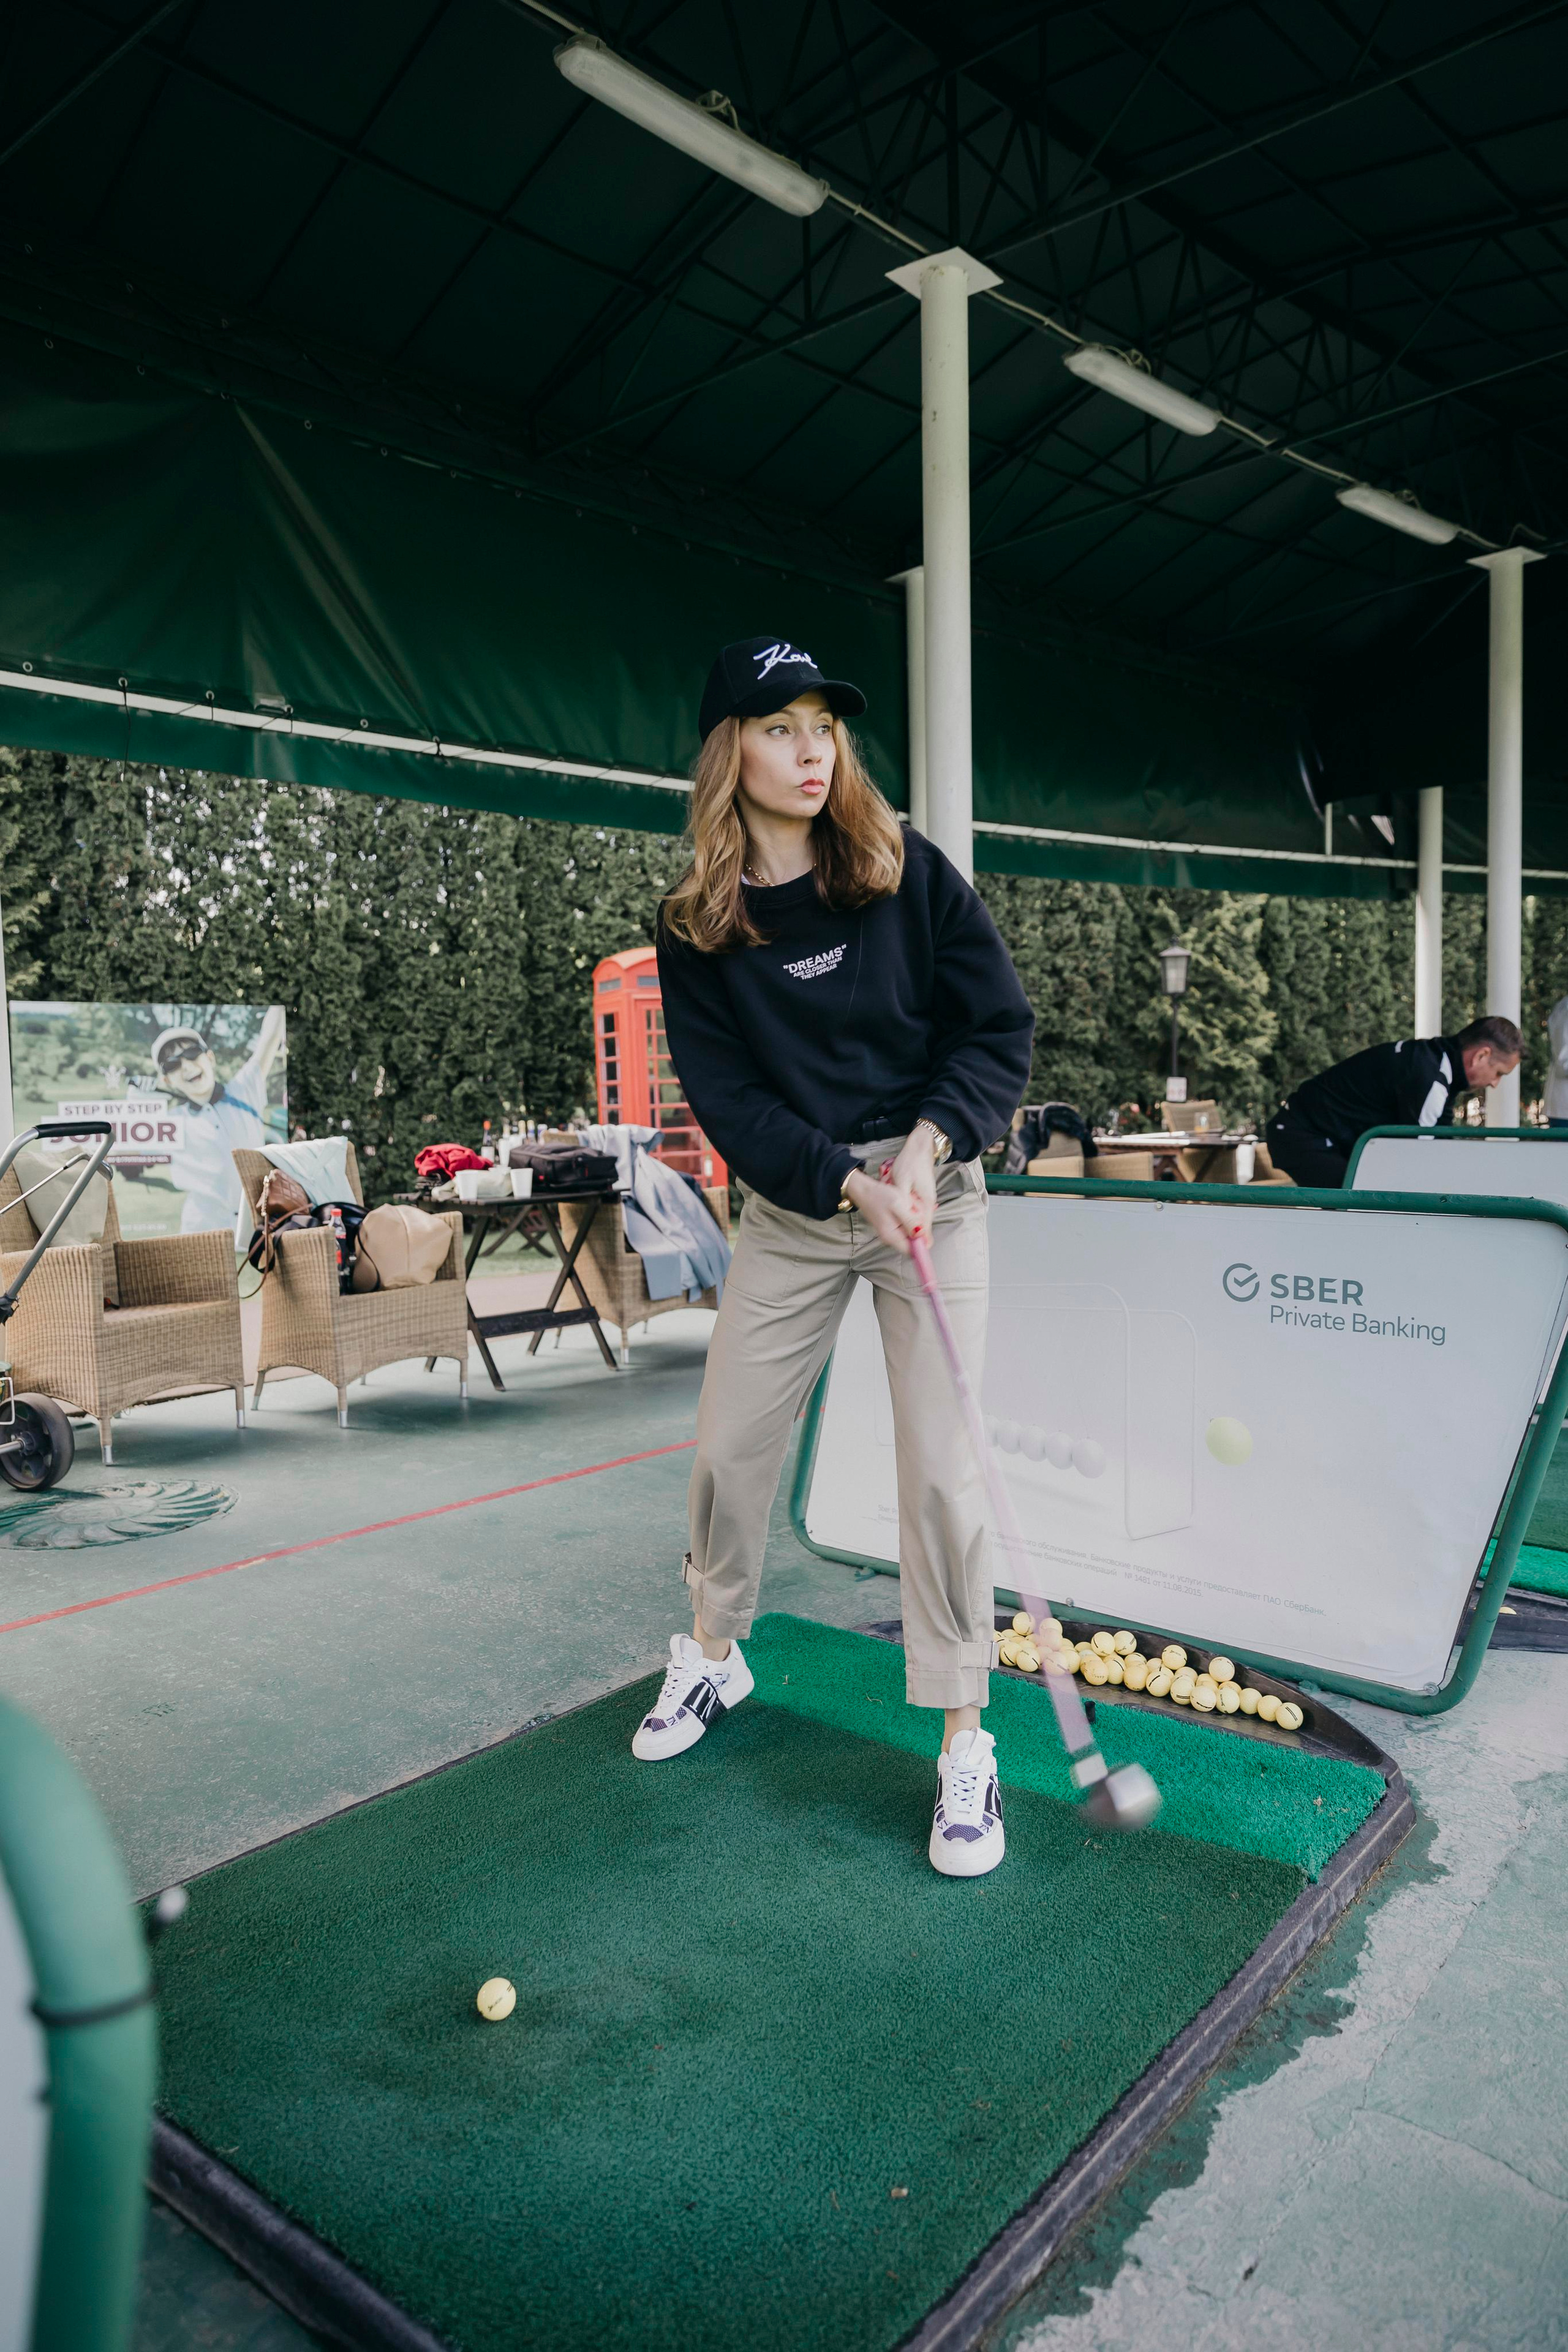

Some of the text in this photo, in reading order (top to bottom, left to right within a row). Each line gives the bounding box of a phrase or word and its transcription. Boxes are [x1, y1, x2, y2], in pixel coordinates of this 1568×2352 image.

[783, 943, 846, 974] "DREAMS"
[800, 963, 838, 980] THEY APPEAR
[805, 963, 827, 974] CLOSER
[827, 956, 843, 966] THAN
[65, 1103, 162, 1116] STEP BY STEP
[1270, 1273, 1364, 1306] SBER
[1270, 1305, 1446, 1346] Private Banking
[1038, 1542, 1088, 1559] обслуживания.
[1090, 1553, 1131, 1569] Банковские
[1133, 1565, 1167, 1578] продукты
[1177, 1575, 1202, 1586] услуги
[1204, 1581, 1261, 1600] предоставляет
[1263, 1594, 1281, 1605] ПАО
[1284, 1600, 1327, 1616] СберБанк.
[1044, 1552, 1082, 1568] банковских
[1084, 1563, 1117, 1577] операций
[1134, 1574, 1150, 1585] 1481
